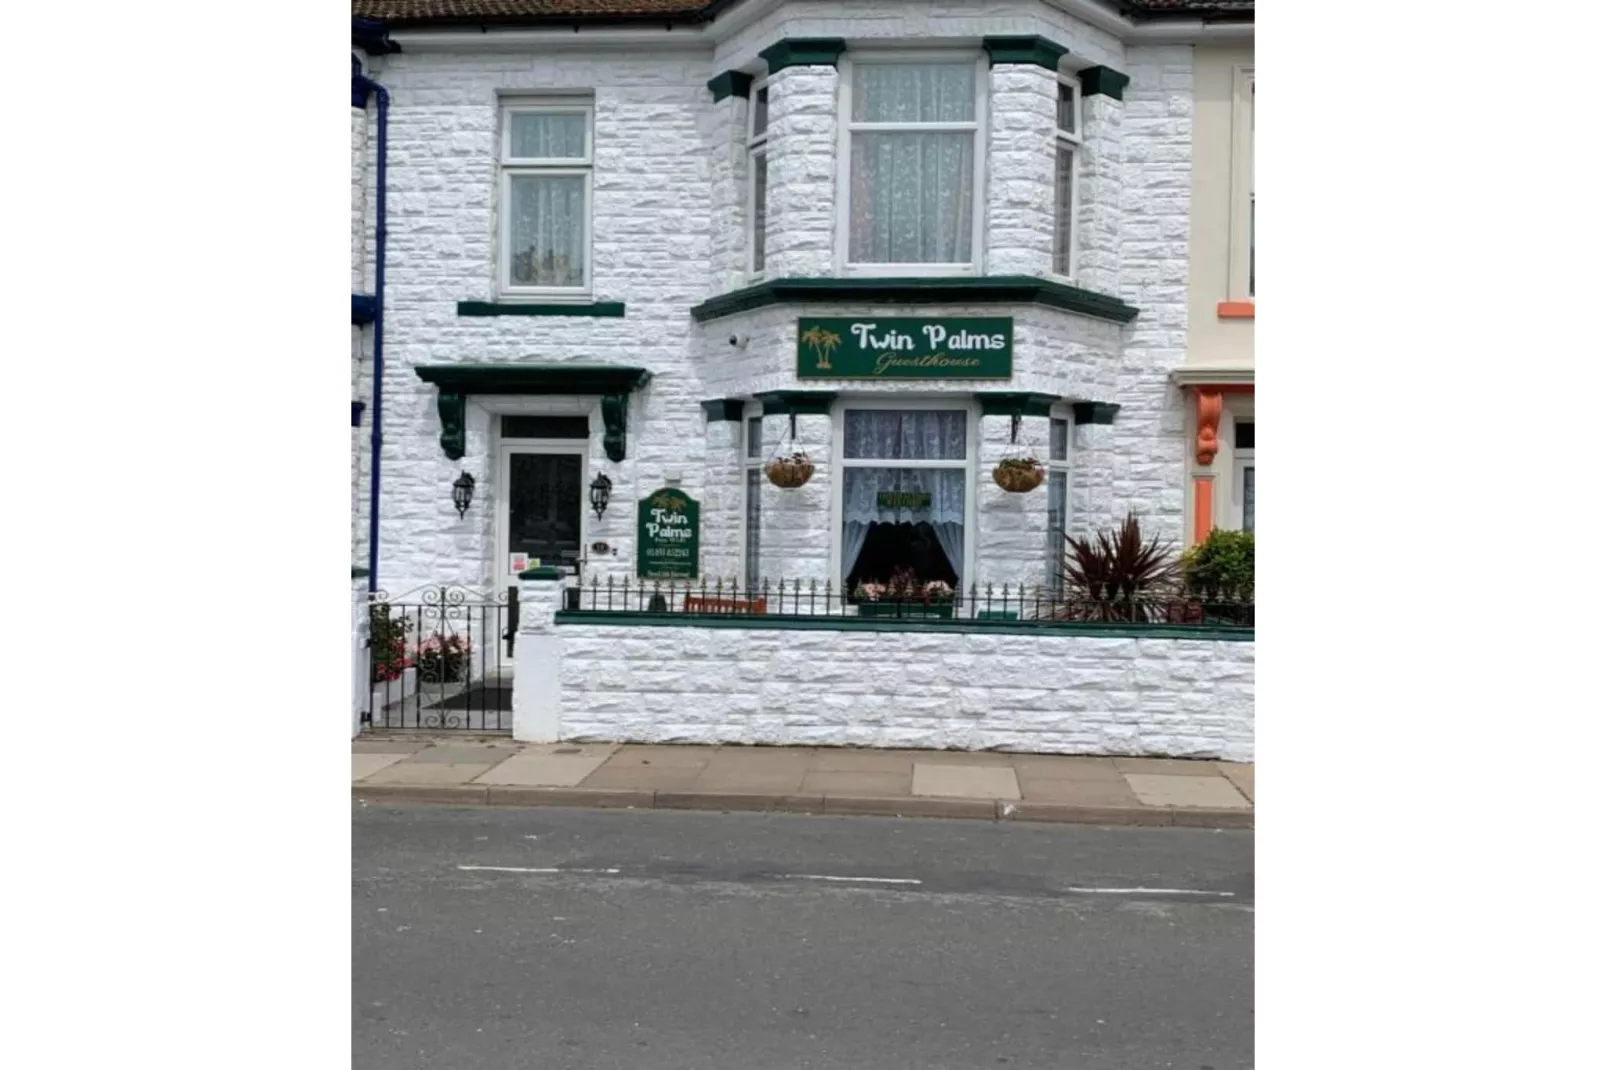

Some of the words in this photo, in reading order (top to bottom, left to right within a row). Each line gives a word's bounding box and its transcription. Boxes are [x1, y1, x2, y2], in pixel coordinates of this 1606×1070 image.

[850, 323, 916, 350] Twin
[922, 325, 1006, 350] Palms
[874, 352, 981, 375] Guesthouse
[650, 508, 688, 525] Twin
[645, 522, 693, 538] Palms
